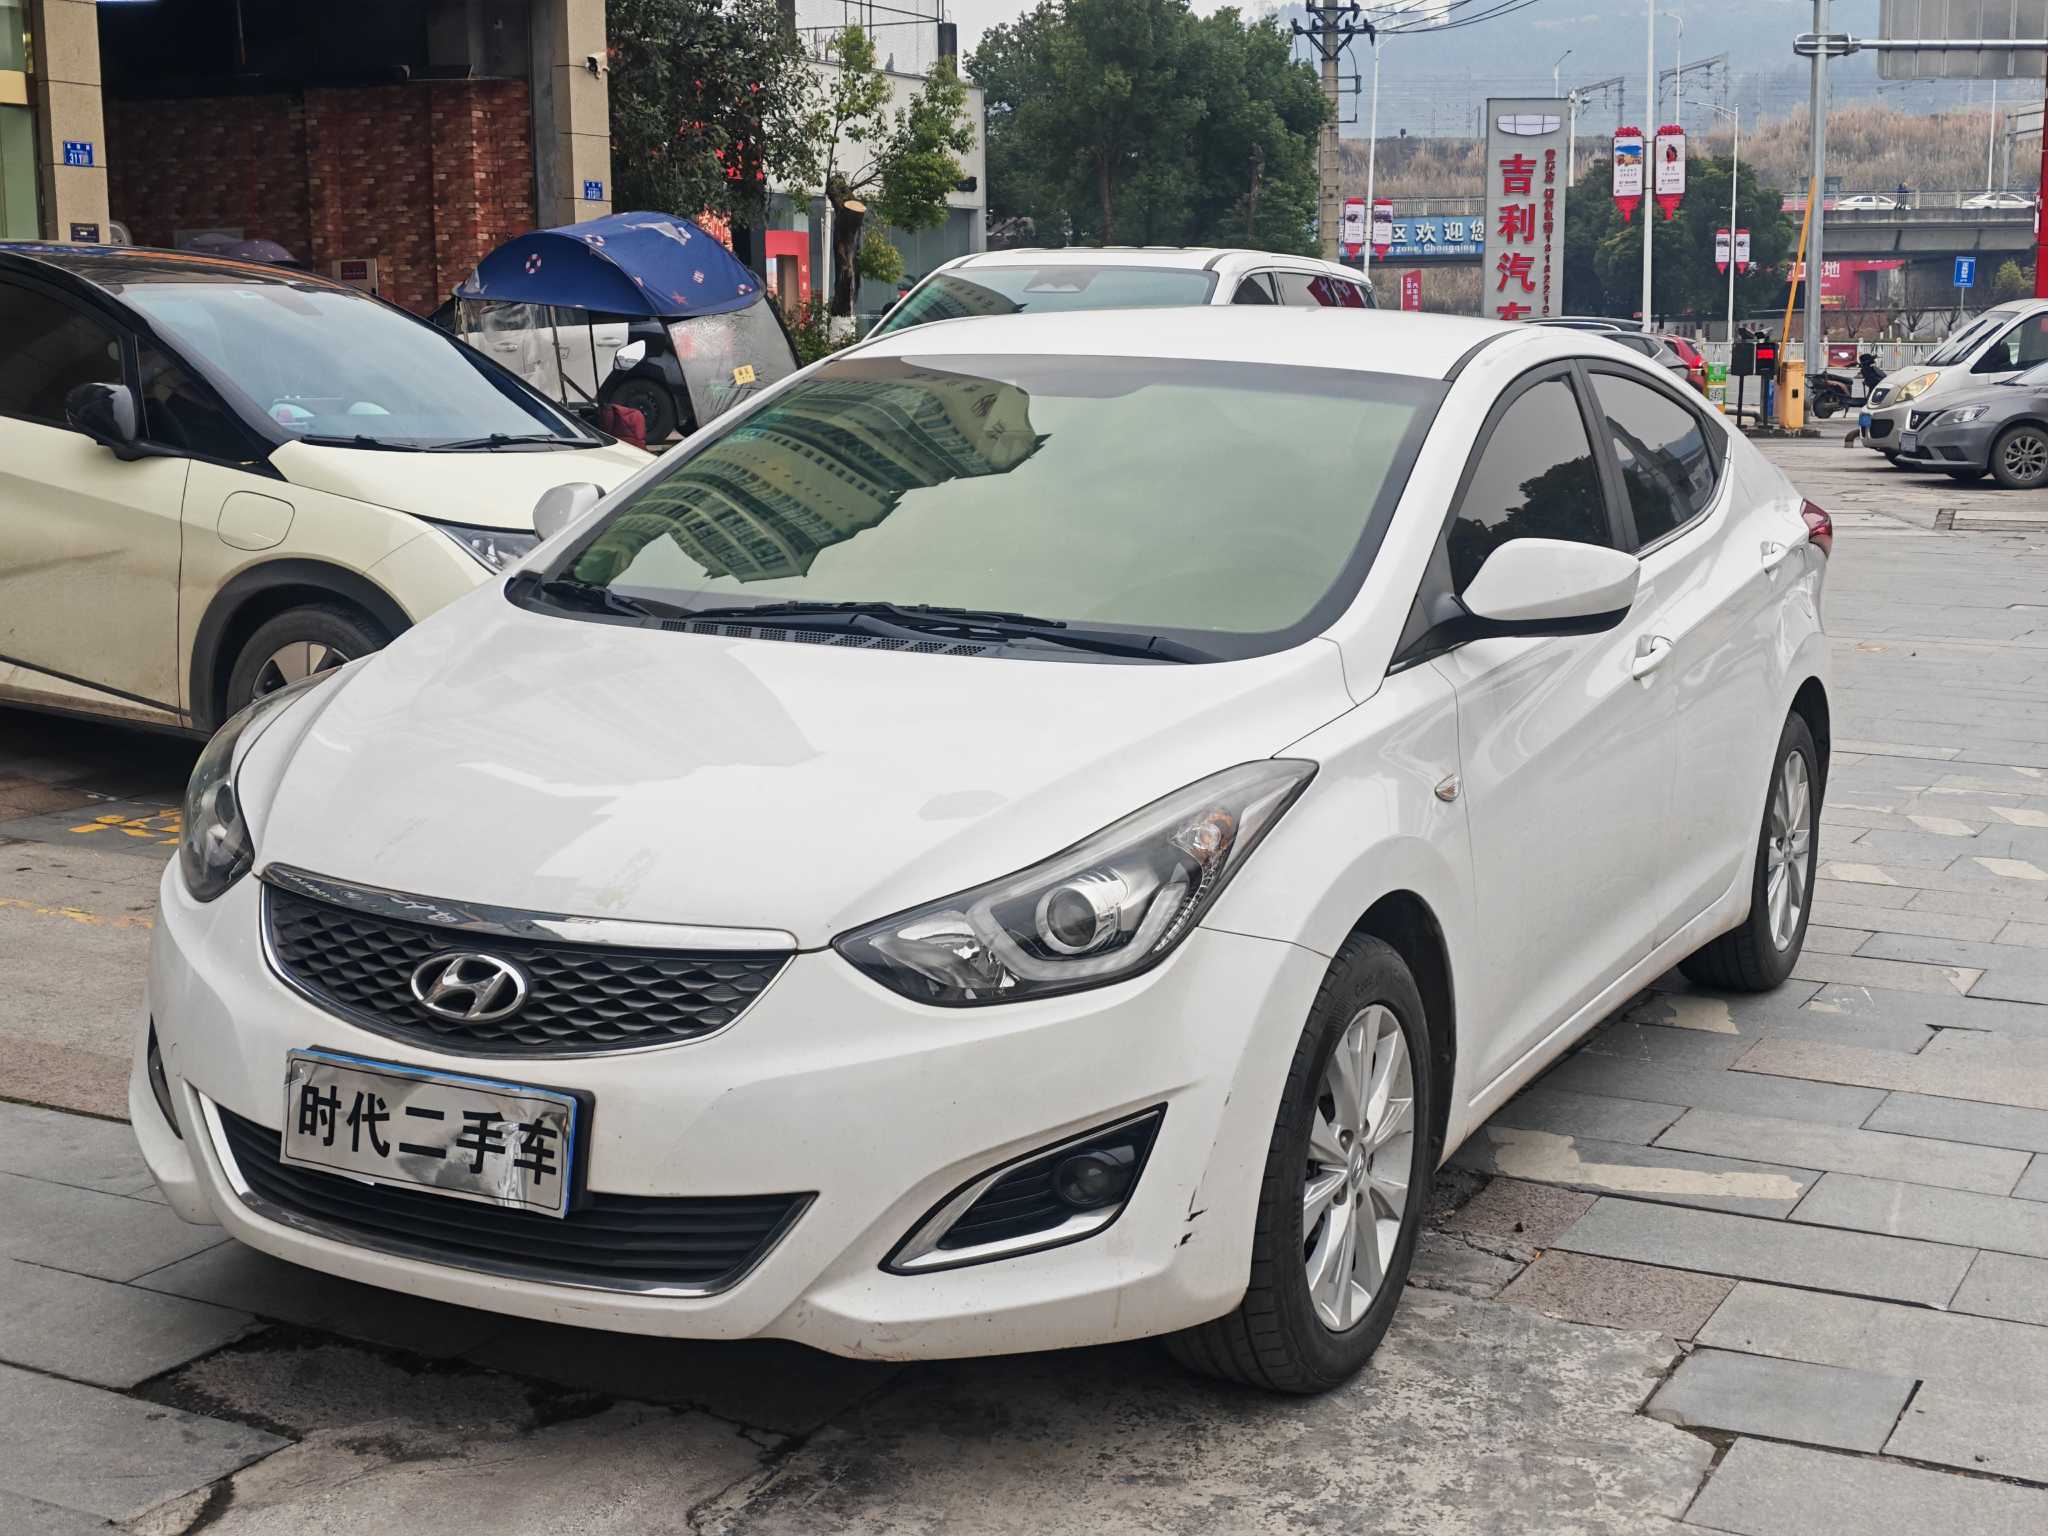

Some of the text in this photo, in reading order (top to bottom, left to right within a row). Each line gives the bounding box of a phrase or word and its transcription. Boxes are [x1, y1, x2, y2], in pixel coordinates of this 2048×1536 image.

[1424, 244, 1476, 254] Chongqing
[298, 1085, 557, 1185] 时代二手车
